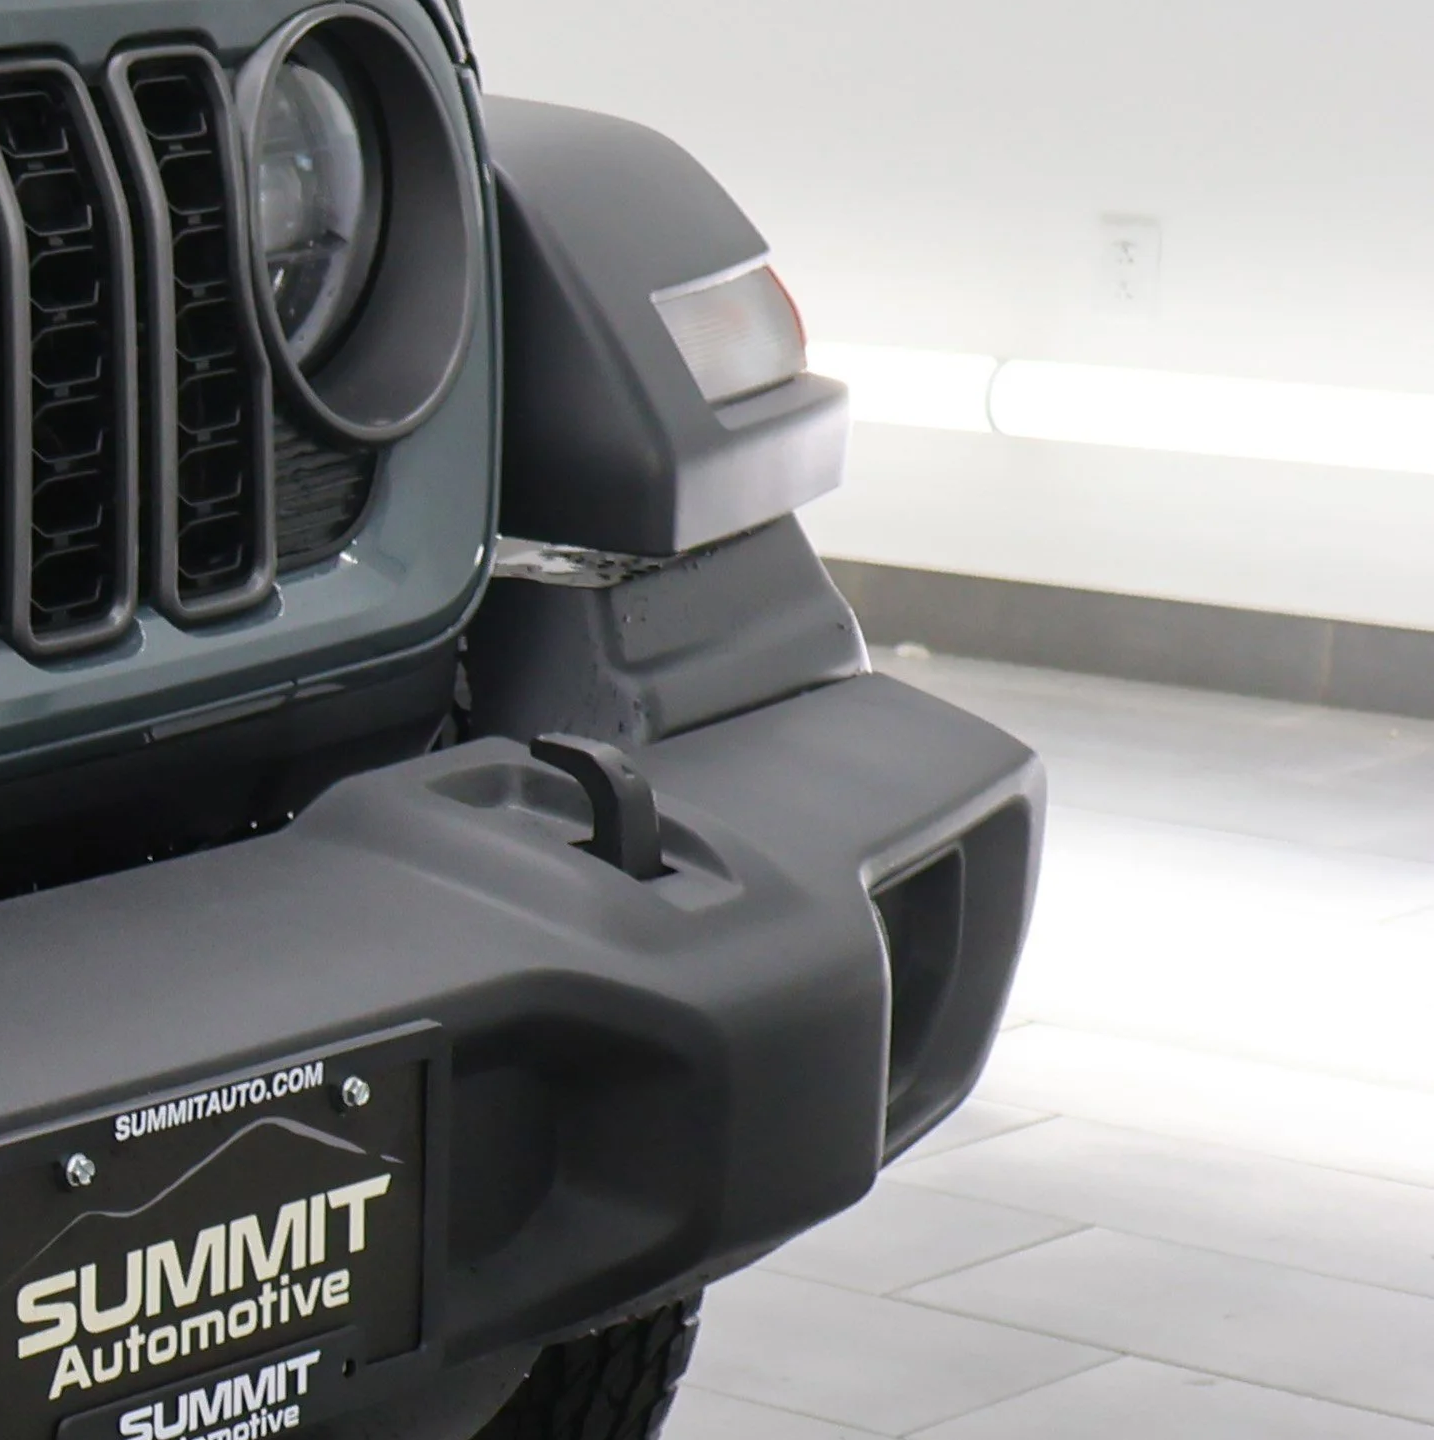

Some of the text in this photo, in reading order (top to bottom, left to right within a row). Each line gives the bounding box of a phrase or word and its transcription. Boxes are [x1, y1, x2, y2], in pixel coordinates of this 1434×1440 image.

[113, 1060, 325, 1142] SUMMITAUTO.COM
[17, 1172, 392, 1359] SUMMIT
[48, 1268, 351, 1400] Automotive
